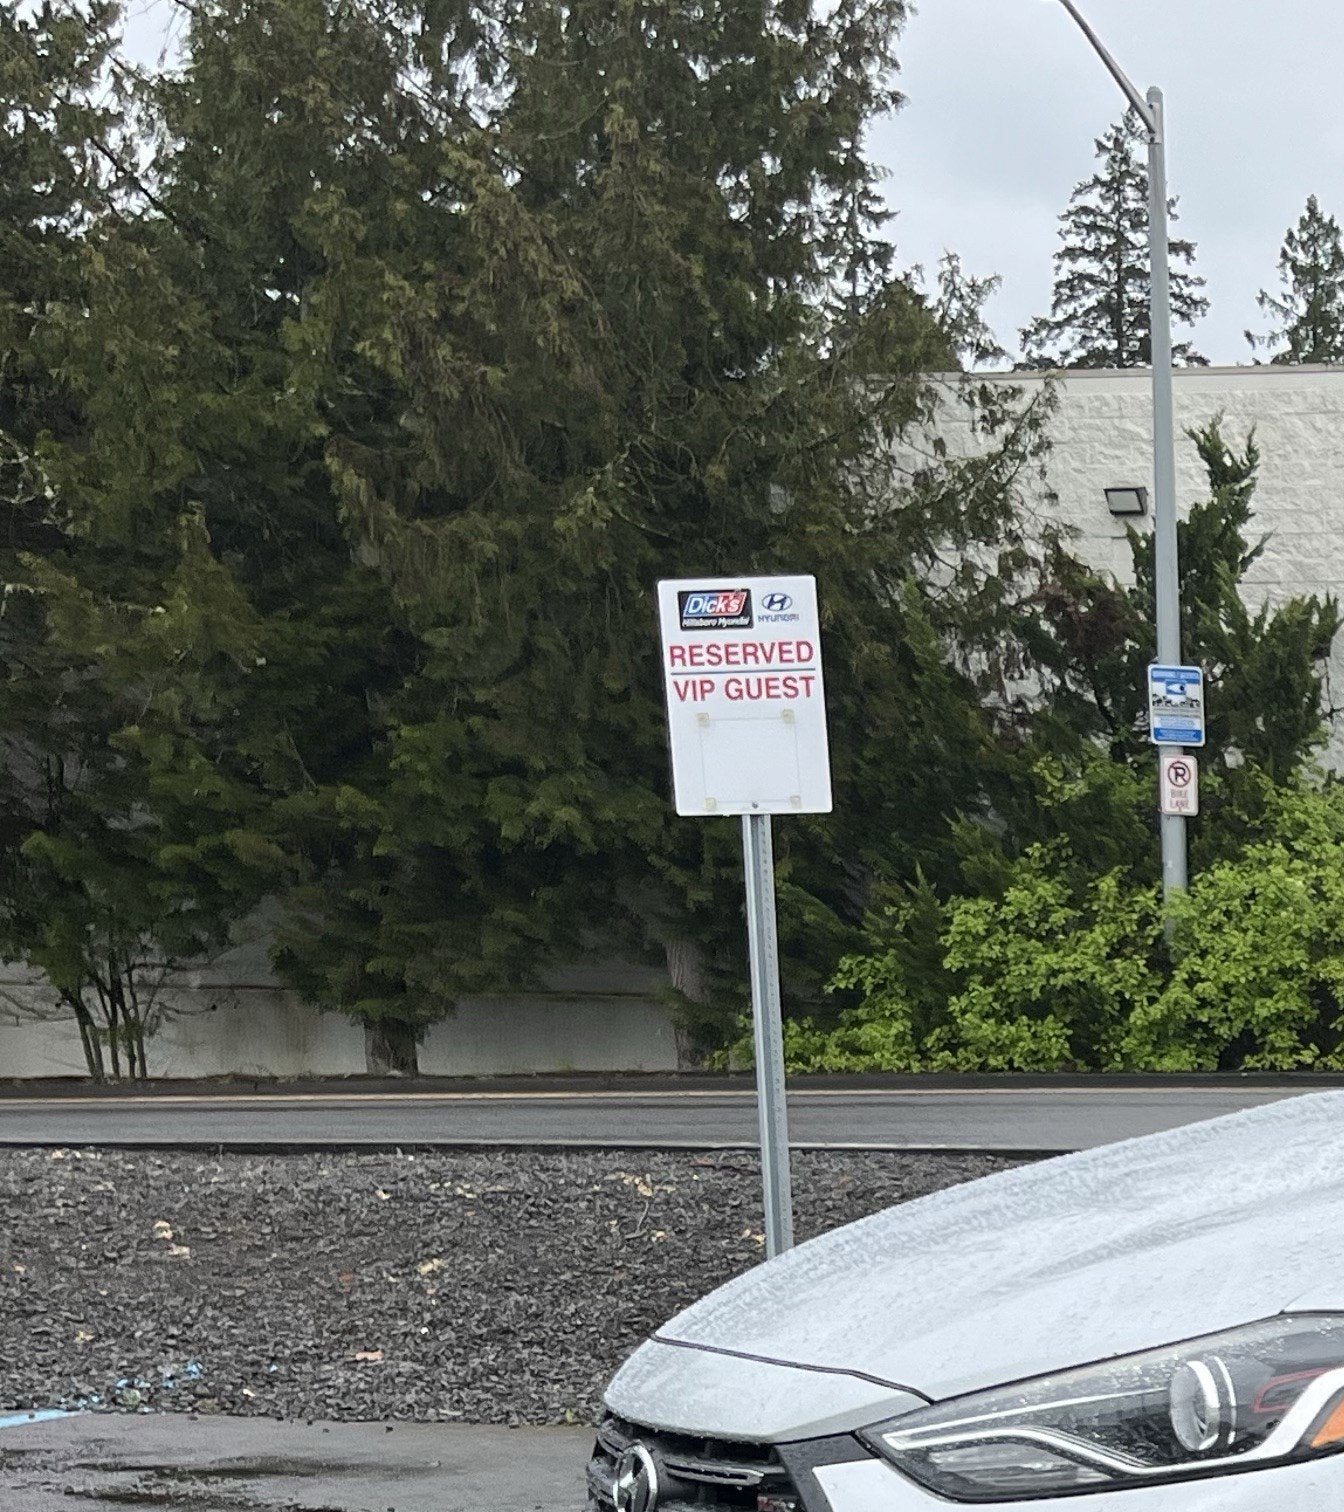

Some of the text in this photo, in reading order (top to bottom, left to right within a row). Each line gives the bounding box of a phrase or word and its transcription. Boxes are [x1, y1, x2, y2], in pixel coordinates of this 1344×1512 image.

[669, 640, 815, 667] RESERVED
[673, 676, 815, 702] VIP GUEST
